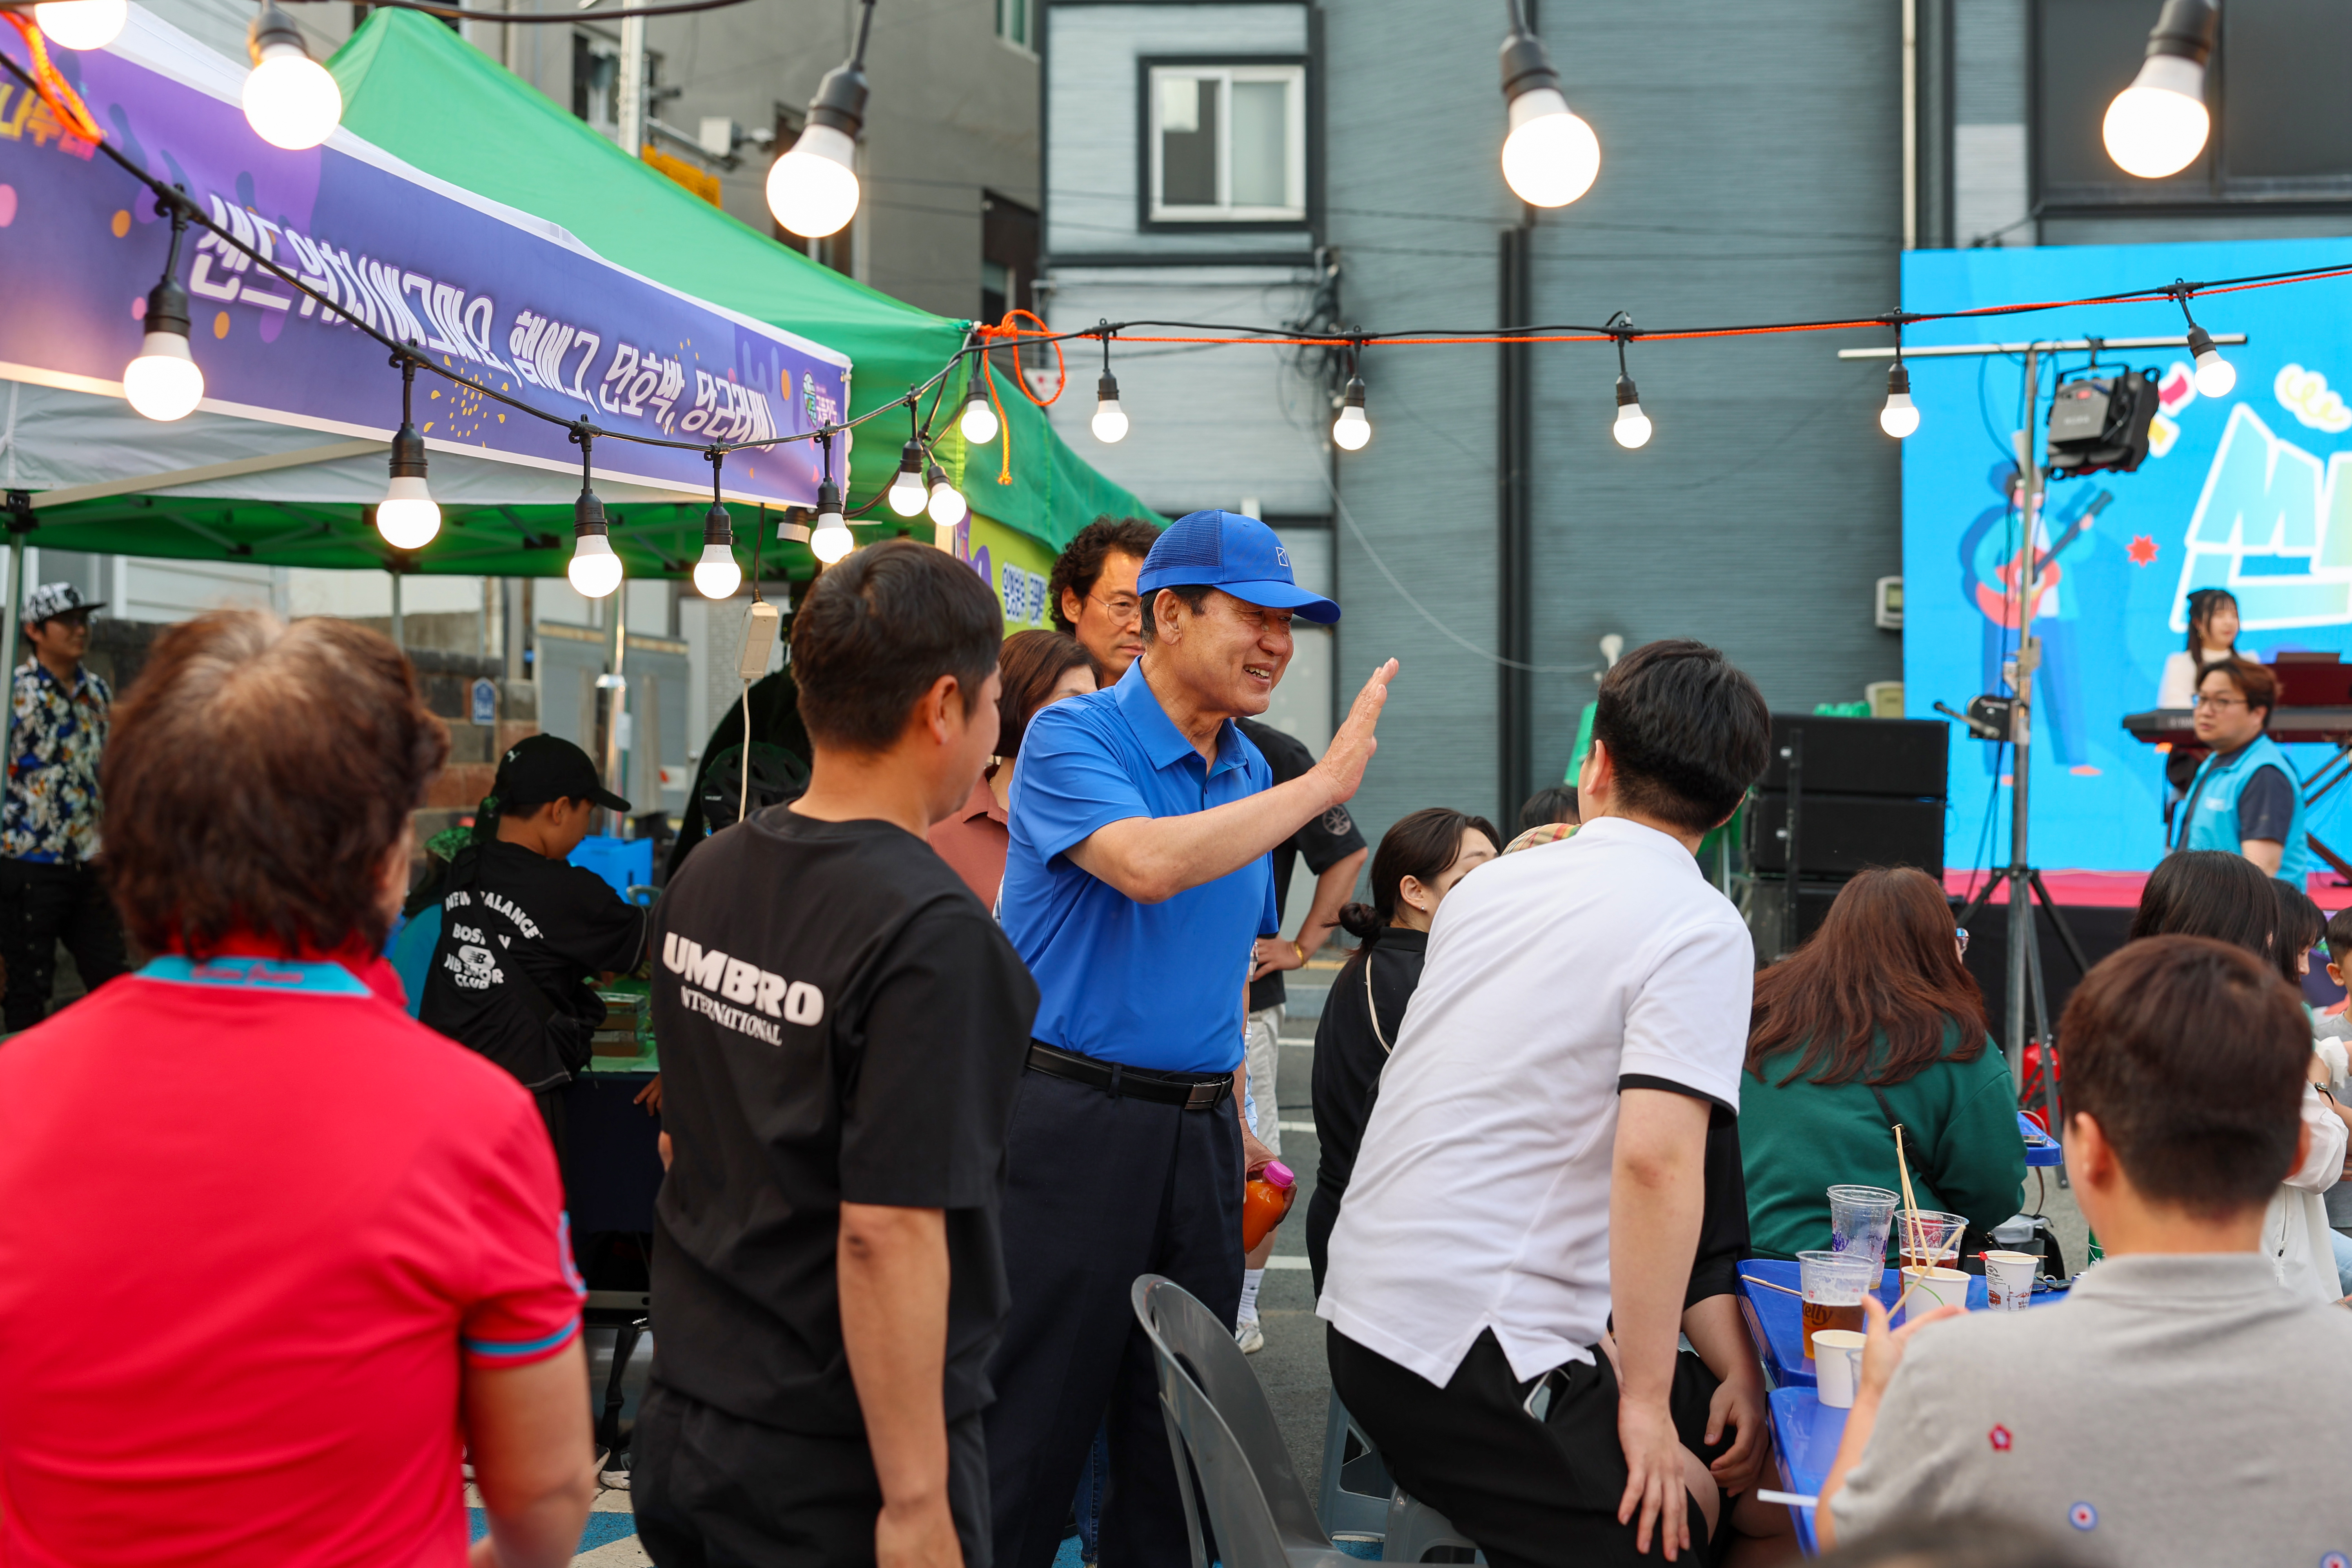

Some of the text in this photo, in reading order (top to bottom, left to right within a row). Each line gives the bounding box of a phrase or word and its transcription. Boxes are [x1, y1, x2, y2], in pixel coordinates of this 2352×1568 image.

[510, 310, 601, 416] 햄에그,
[600, 341, 685, 436] 단호박,
[680, 369, 777, 453] 당근라페)
[452, 922, 511, 950] BOSN
[480, 891, 540, 939] ALANCE
[662, 931, 824, 1026] UMBRO
[681, 985, 782, 1046] NTERNATIONAL
